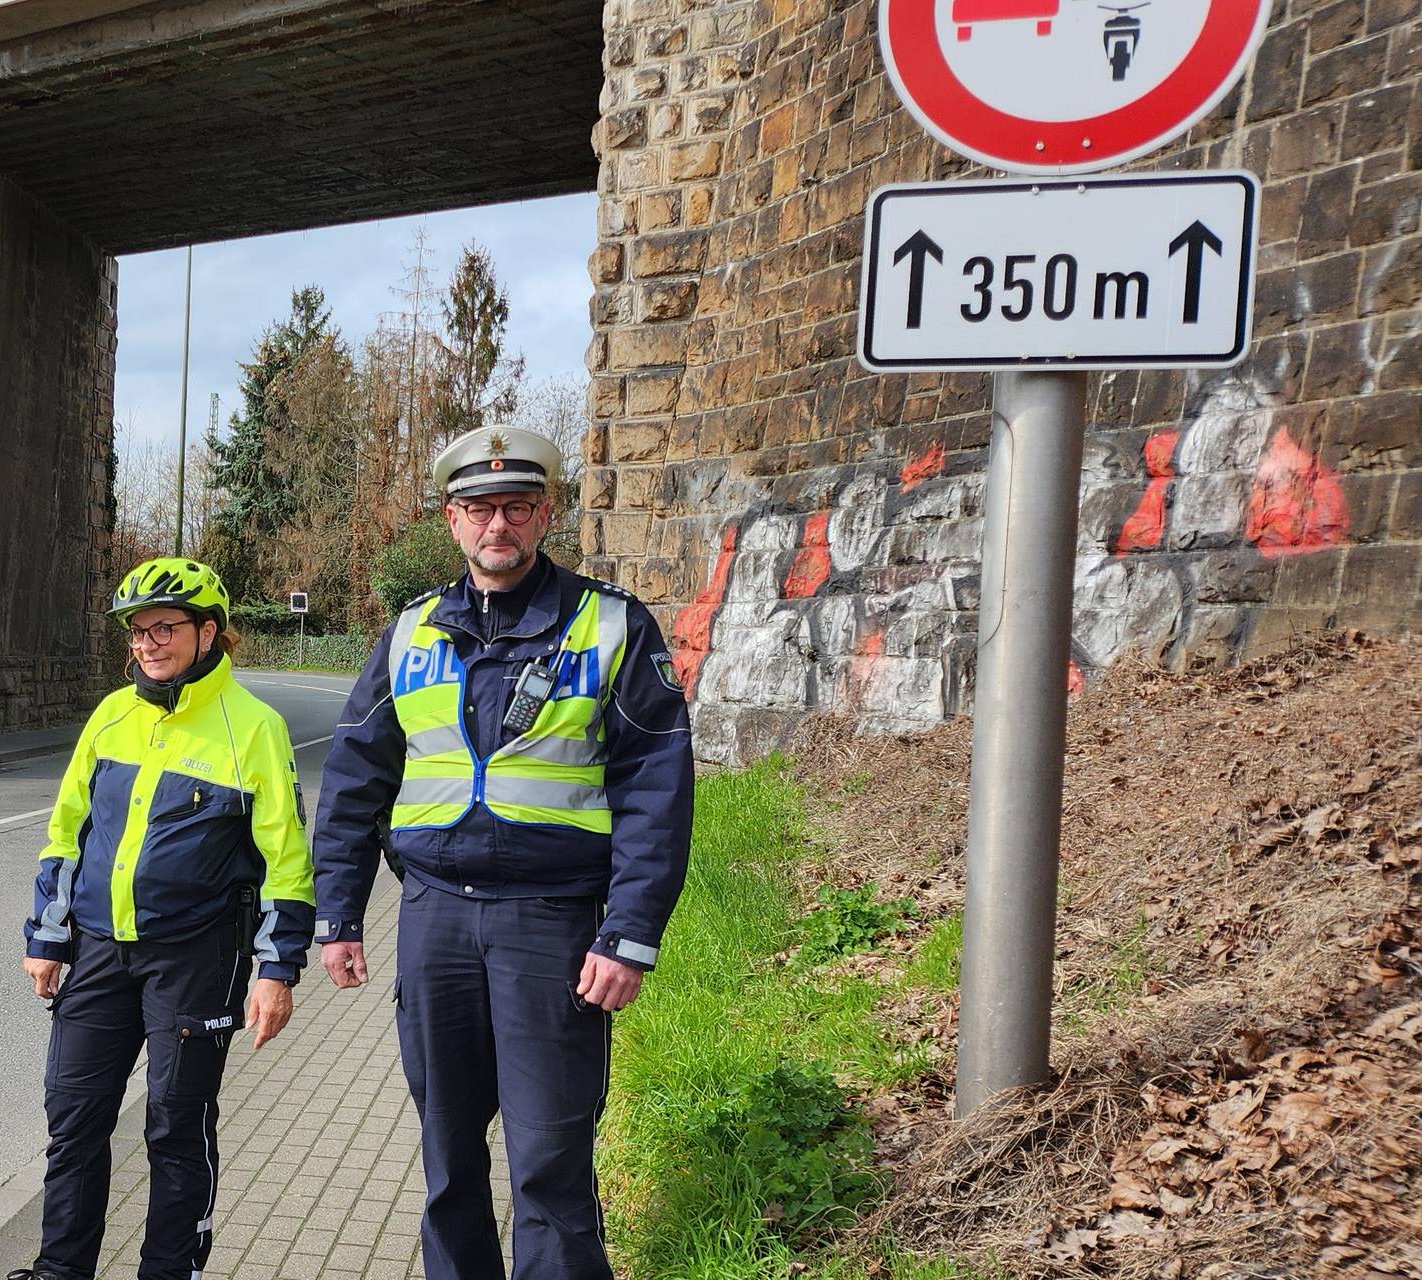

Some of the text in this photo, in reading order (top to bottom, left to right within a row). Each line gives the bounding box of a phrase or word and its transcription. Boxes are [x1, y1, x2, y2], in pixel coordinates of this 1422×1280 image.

[960, 253, 1150, 323] 350 m
[179, 757, 213, 773] POLIZEI
[204, 1016, 233, 1031] POLIZEI
